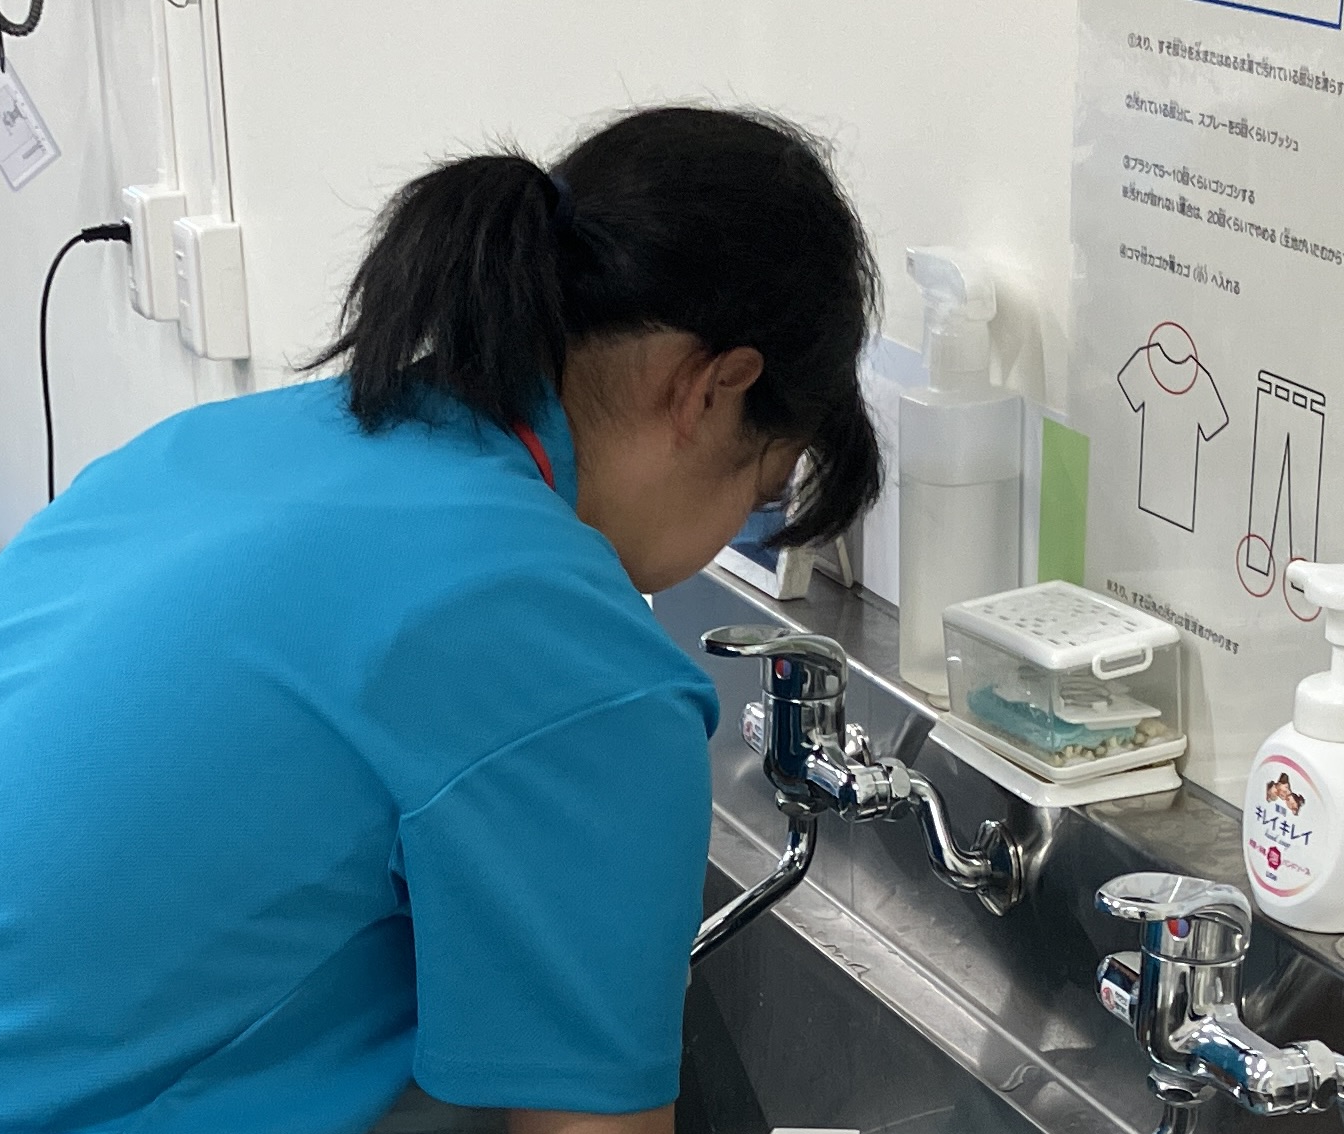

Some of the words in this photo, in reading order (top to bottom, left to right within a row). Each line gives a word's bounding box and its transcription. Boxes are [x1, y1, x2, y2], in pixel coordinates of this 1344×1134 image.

[1255, 805, 1313, 846] キレイキレイ
